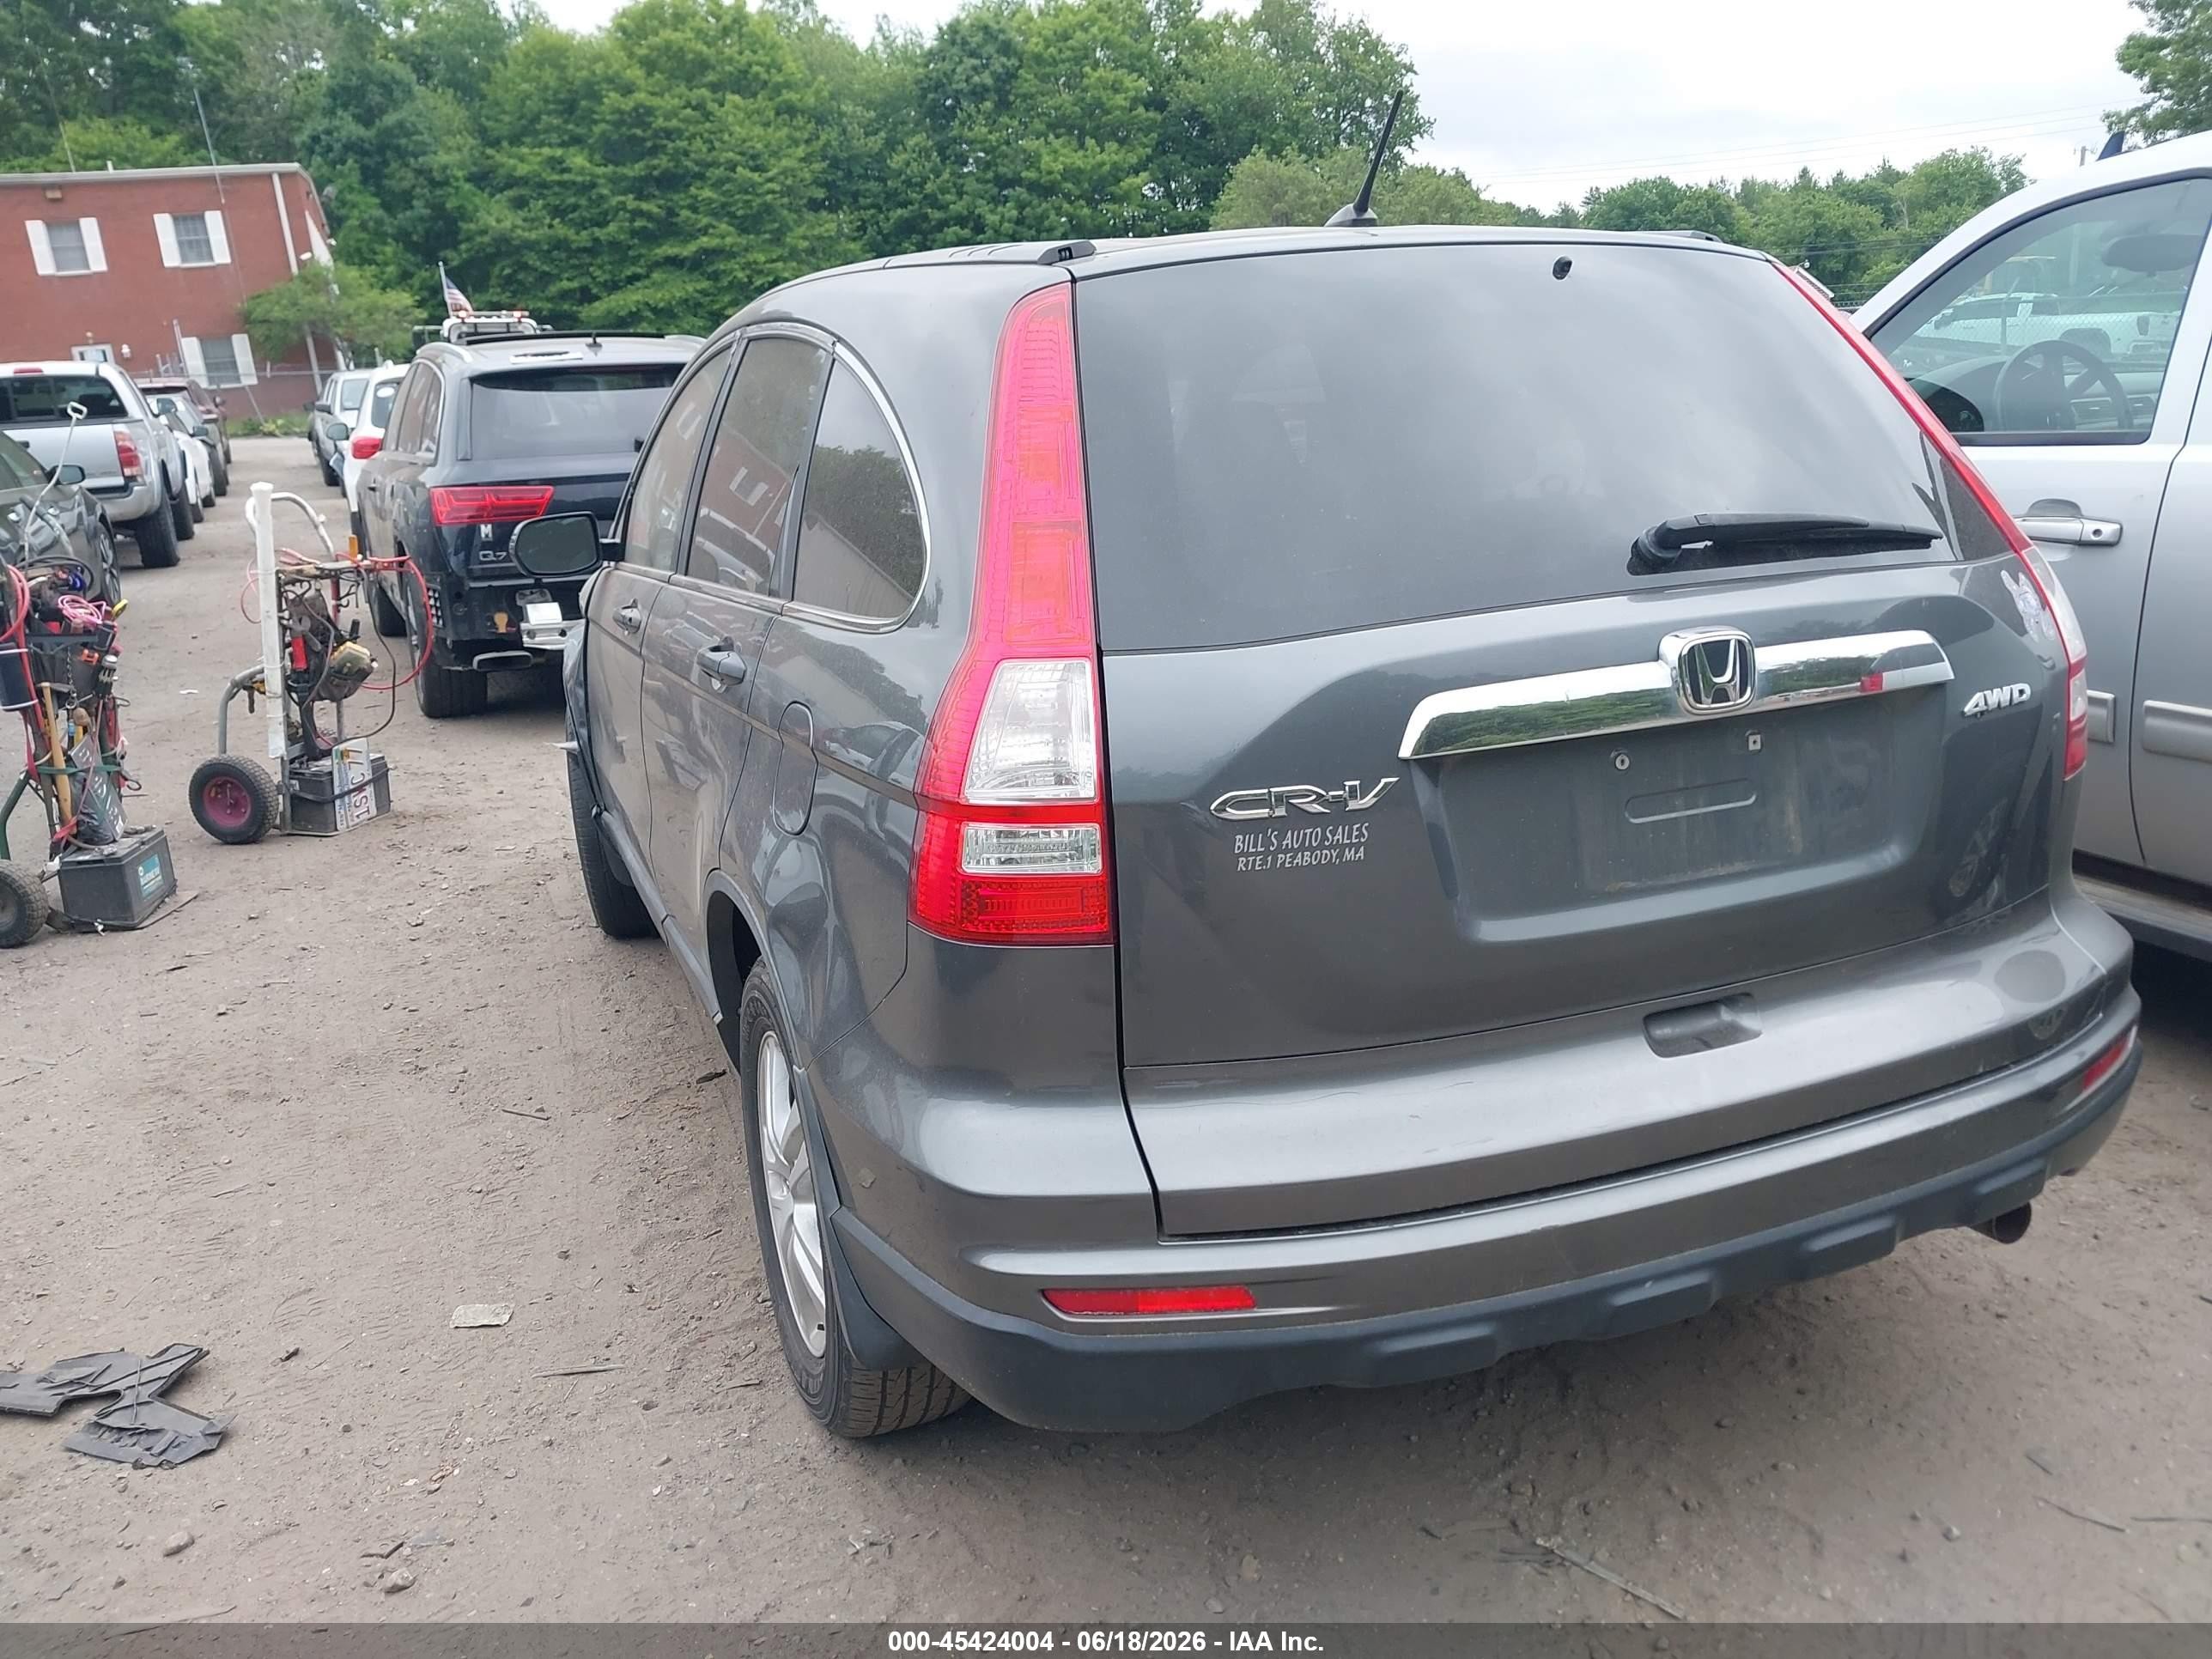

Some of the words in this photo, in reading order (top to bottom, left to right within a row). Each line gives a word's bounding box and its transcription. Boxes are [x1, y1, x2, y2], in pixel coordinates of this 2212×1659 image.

[479, 550, 507, 561] Q7
[1964, 683, 2031, 716] 4WD
[1210, 777, 1400, 821] CR-V
[1234, 829, 1278, 854] BILL'S
[1282, 827, 1322, 850] AUTO
[1324, 823, 1370, 847] SALES
[1276, 848, 1340, 869] PEABODY,
[1343, 846, 1364, 861] MA
